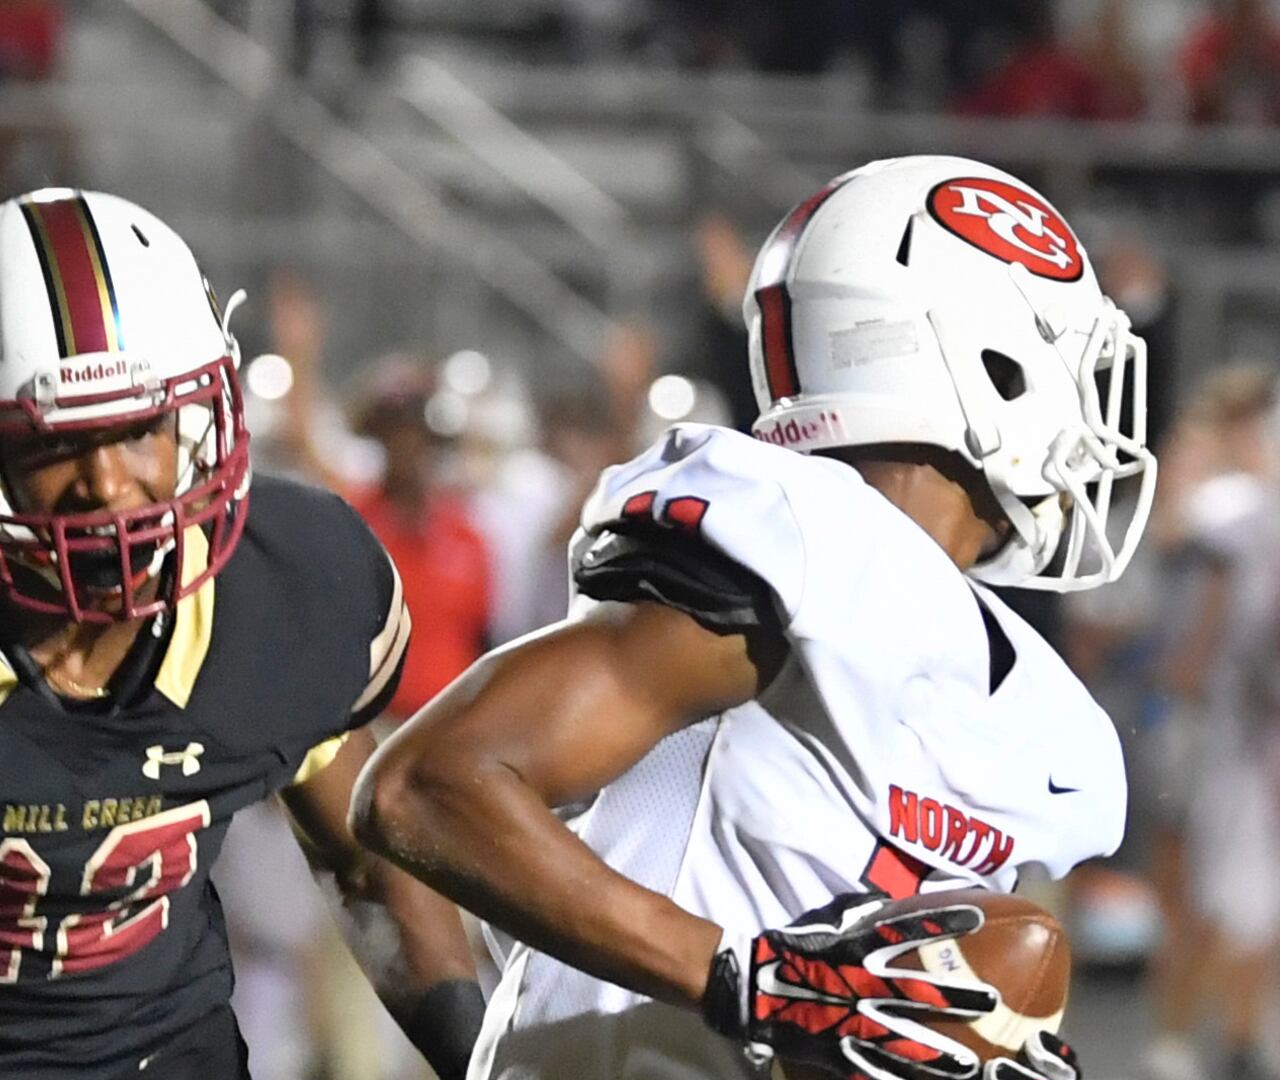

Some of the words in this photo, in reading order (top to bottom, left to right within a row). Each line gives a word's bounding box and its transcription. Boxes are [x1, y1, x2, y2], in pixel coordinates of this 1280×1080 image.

[59, 360, 127, 384] Riddell
[3, 803, 68, 832] MILL
[888, 783, 1014, 876] NORTH
